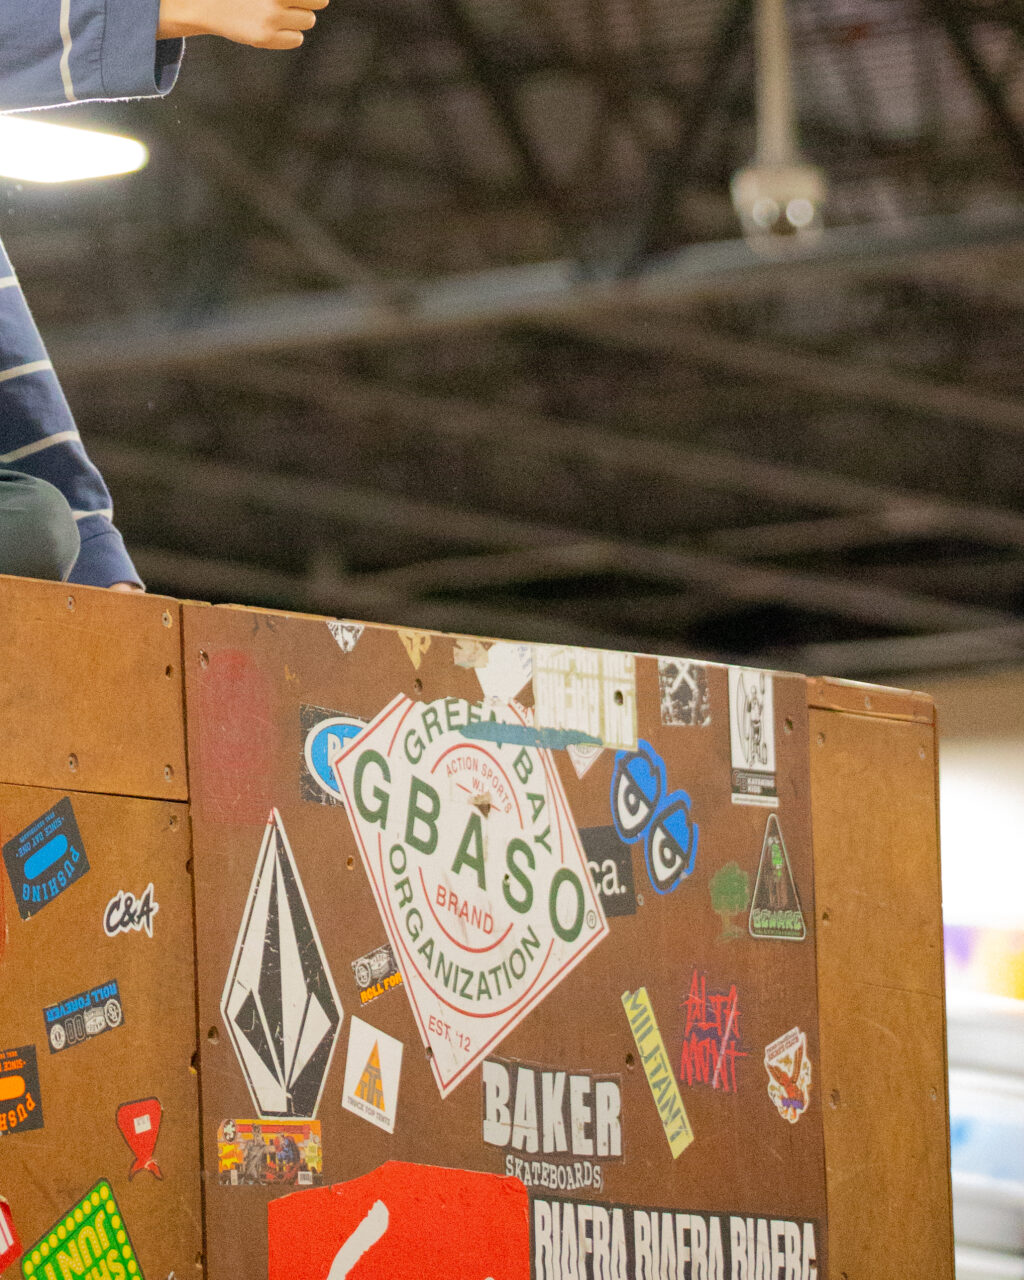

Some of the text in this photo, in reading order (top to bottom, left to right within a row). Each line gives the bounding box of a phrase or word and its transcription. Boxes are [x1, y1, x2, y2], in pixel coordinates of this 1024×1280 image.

[446, 756, 512, 813] ACTION SPORTS
[512, 747, 552, 854] BAY
[18, 817, 63, 857] SINCE DAY ONE
[352, 749, 586, 942] GBASO
[22, 845, 80, 902] PUSHING
[104, 886, 156, 936] C&A
[388, 843, 542, 1001] ORGANIZATION
[437, 884, 494, 936] BRAND
[46, 994, 92, 1022] FOREVER
[91, 983, 118, 1004] ROLL
[360, 973, 403, 1003] ROLL FOR
[428, 1016, 452, 1041] EST.
[4, 1059, 24, 1071] SINCE
[625, 991, 689, 1142] MILITANT
[482, 1059, 622, 1156] BAKER
[505, 1154, 602, 1192] SKATEBOARDS
